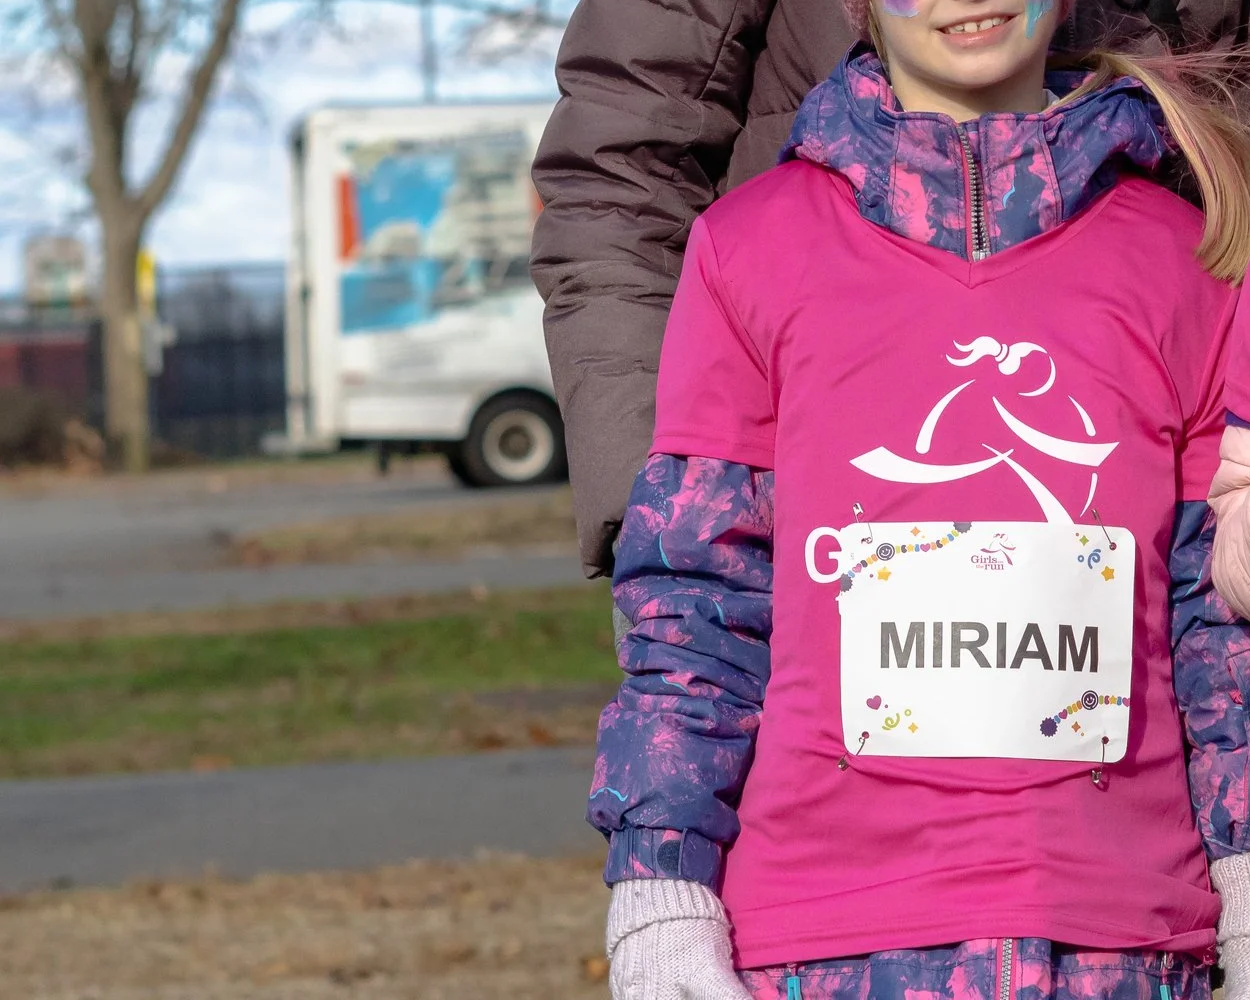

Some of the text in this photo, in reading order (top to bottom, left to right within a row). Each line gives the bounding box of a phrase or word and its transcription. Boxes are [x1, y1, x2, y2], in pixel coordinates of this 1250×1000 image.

[970, 554, 998, 564] Girls
[984, 563, 1004, 571] run
[880, 621, 1099, 673] MIRIAM
